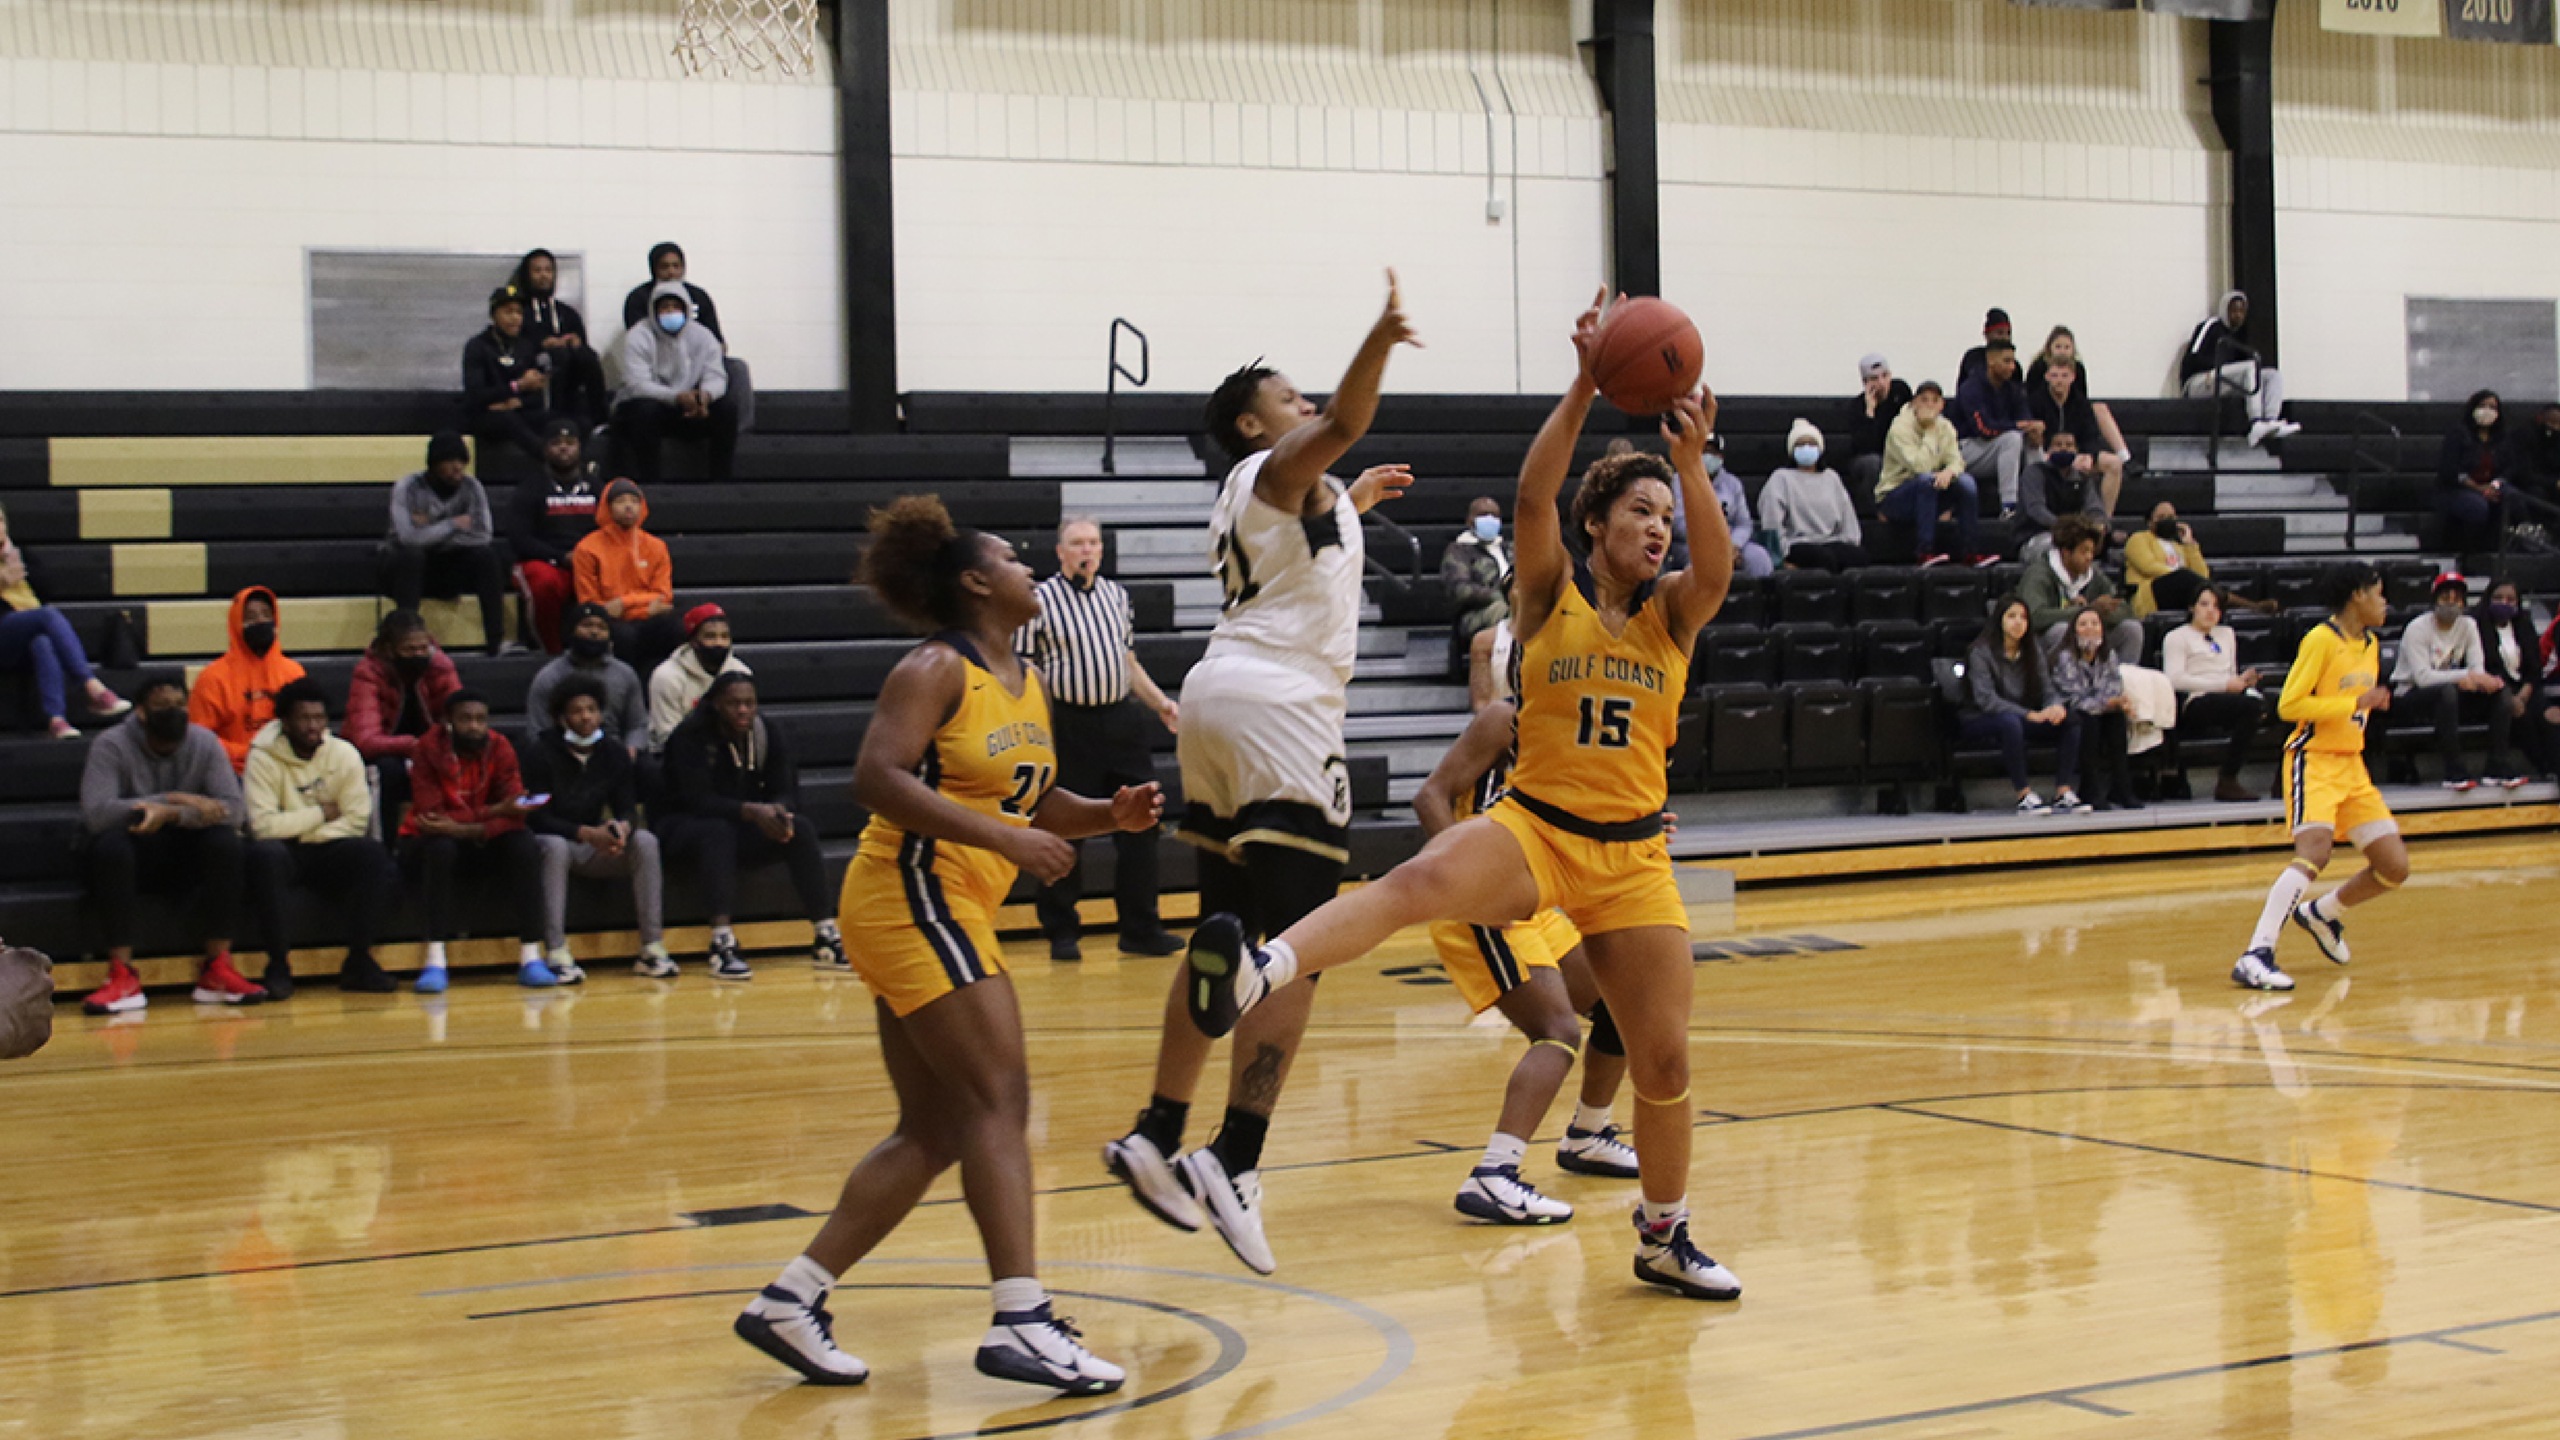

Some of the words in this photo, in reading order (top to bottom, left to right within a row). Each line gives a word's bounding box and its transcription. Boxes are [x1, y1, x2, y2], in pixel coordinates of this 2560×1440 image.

[2462, 0, 2513, 24] 2010
[1549, 655, 1595, 684] GULF
[1603, 656, 1664, 694] COAST
[1576, 696, 1634, 748] 15
[1000, 763, 1053, 820] 21
